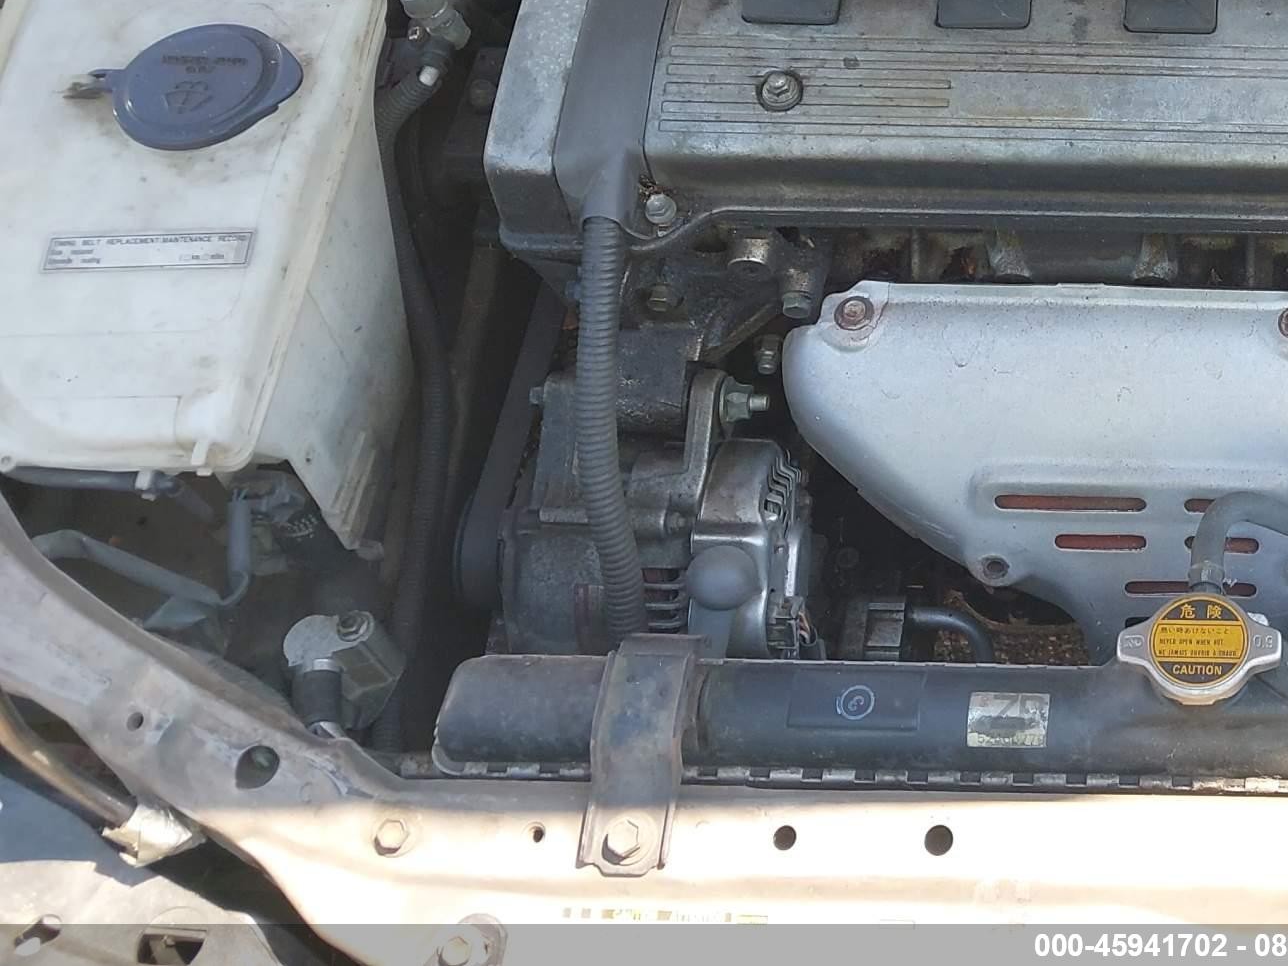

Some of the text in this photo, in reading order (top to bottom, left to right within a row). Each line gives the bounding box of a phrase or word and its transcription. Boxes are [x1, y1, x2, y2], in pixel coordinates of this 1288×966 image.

[1178, 638, 1193, 646] OPEN
[1195, 638, 1211, 646] WHEN
[1172, 664, 1222, 675] CAUTION
